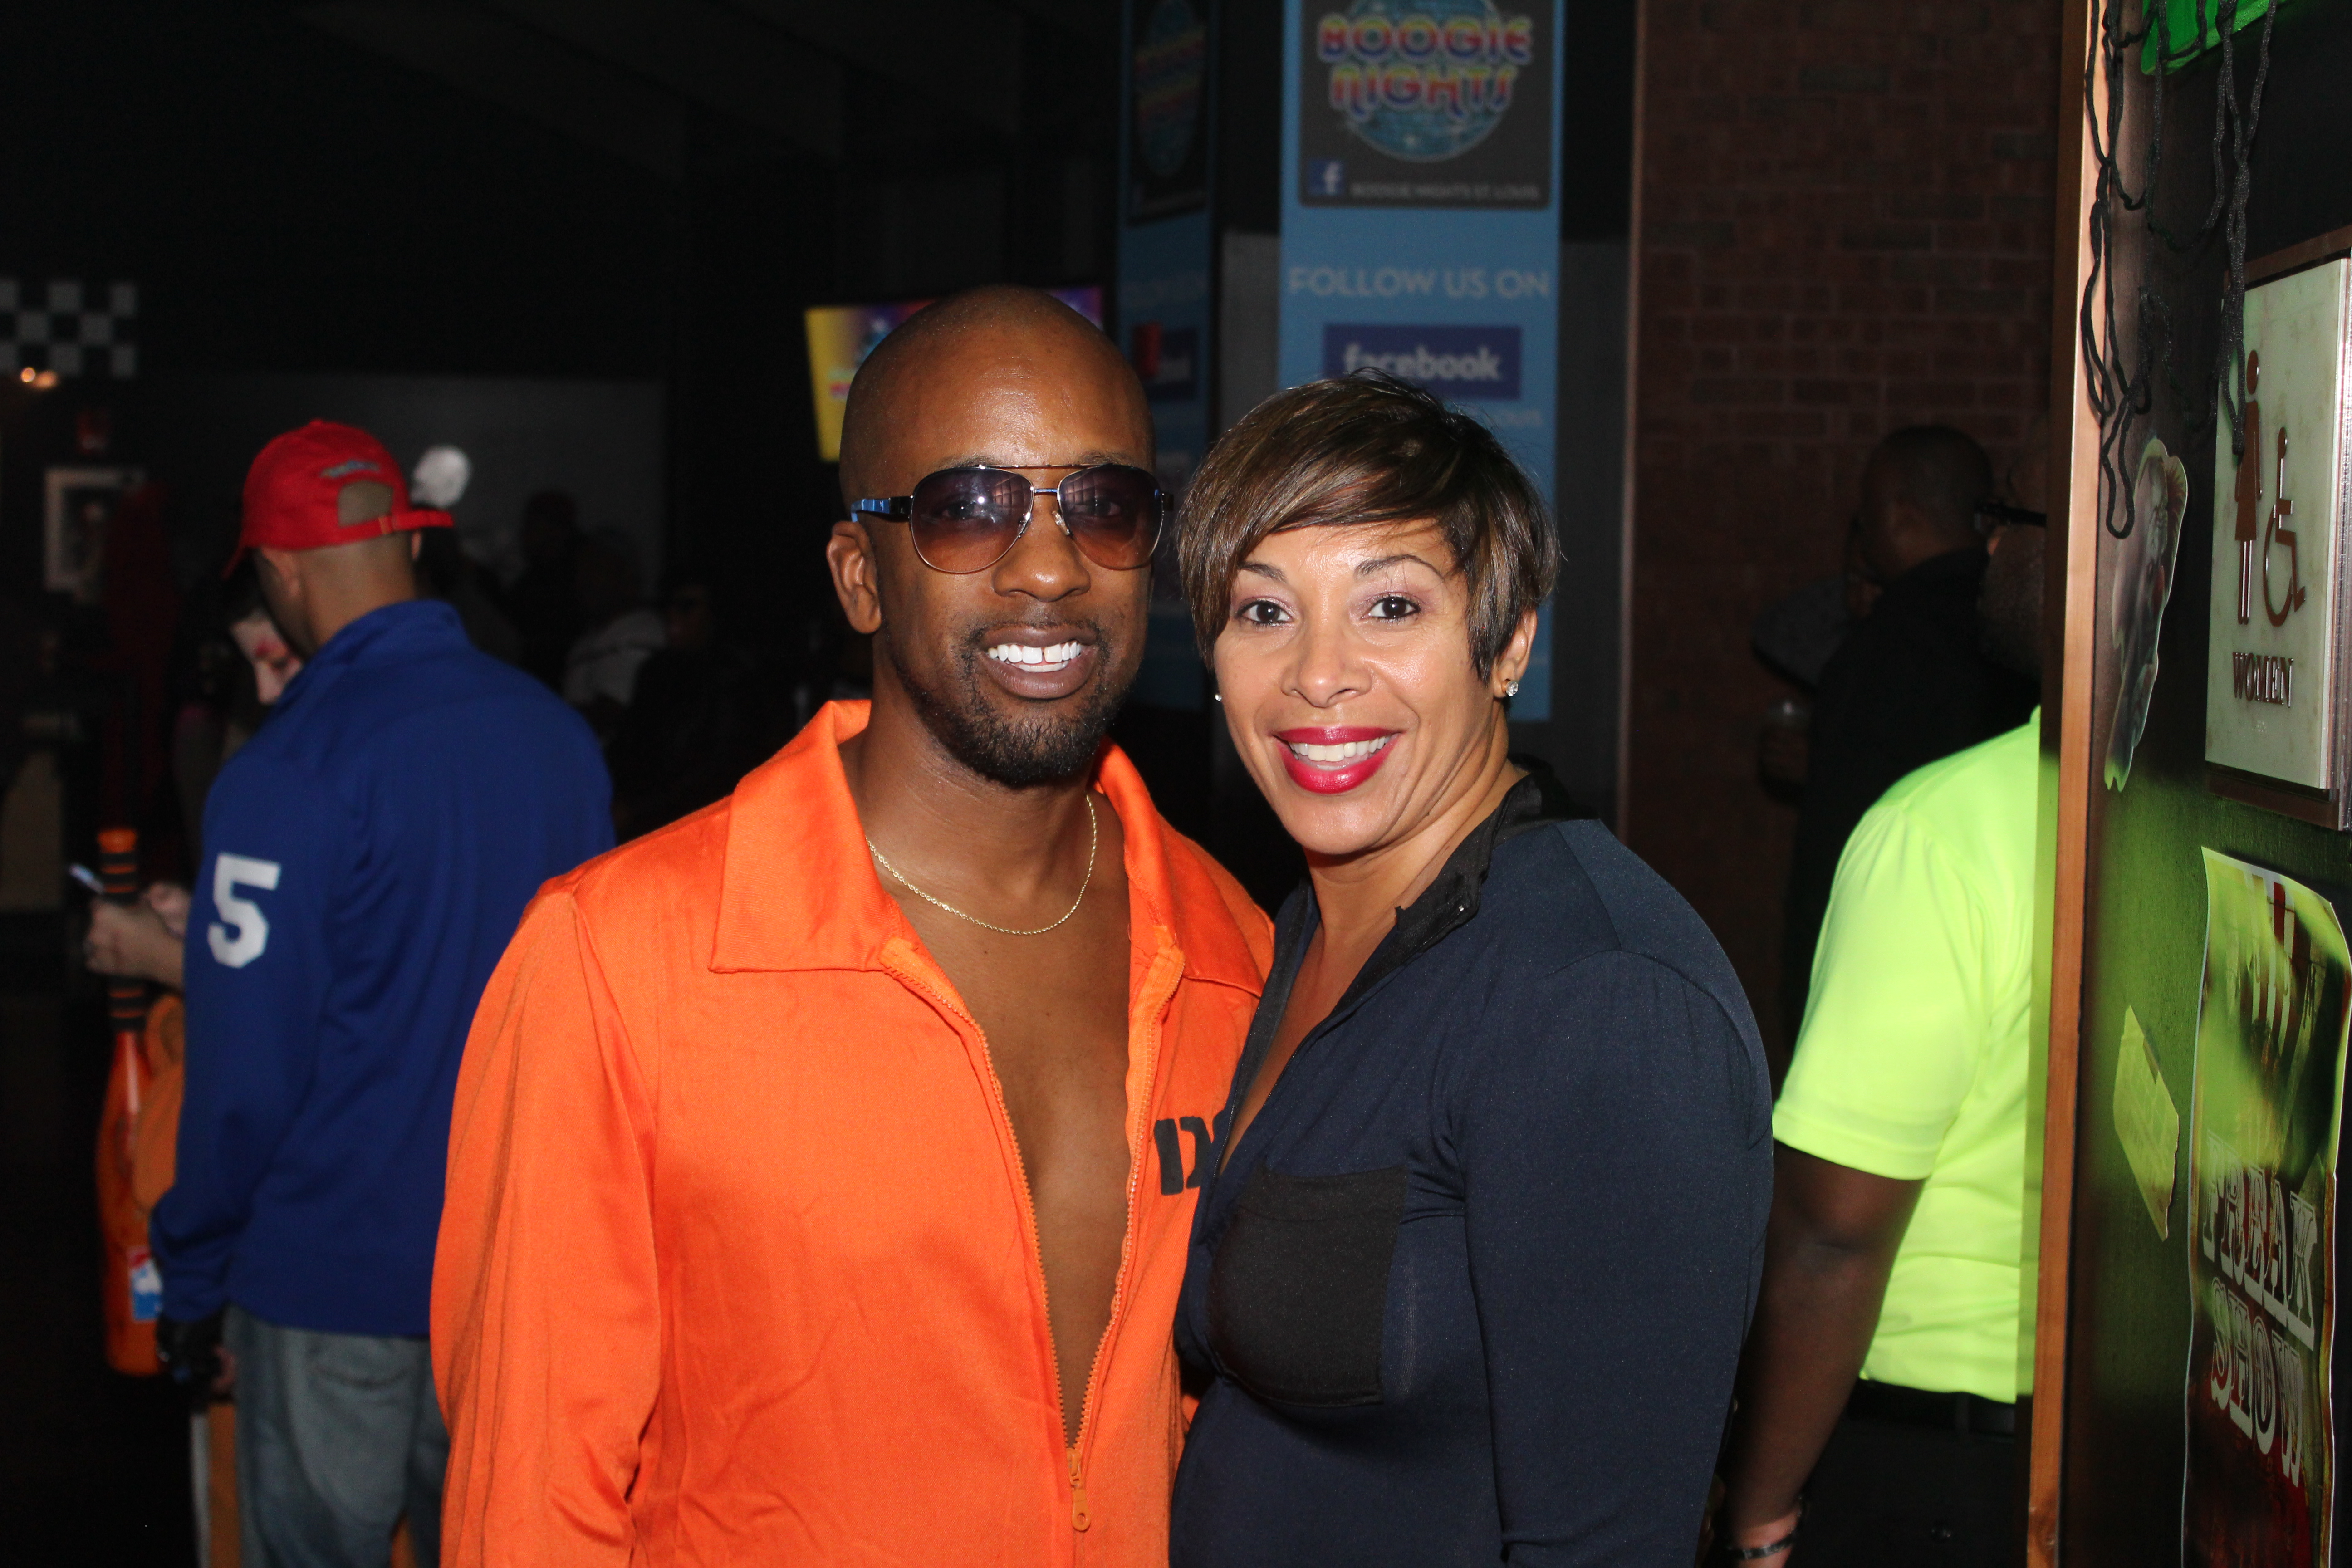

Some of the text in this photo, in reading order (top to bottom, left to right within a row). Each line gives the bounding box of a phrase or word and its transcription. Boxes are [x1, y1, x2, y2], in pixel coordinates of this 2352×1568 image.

[1318, 14, 1532, 62] BOOGIE
[1288, 267, 1550, 299] FOLLOW US ON
[1344, 342, 1501, 381] facebook
[2232, 652, 2294, 708] WOMEN
[207, 852, 282, 968] 5
[2203, 1130, 2317, 1351] FREAK
[2211, 1277, 2304, 1487] SHOW
